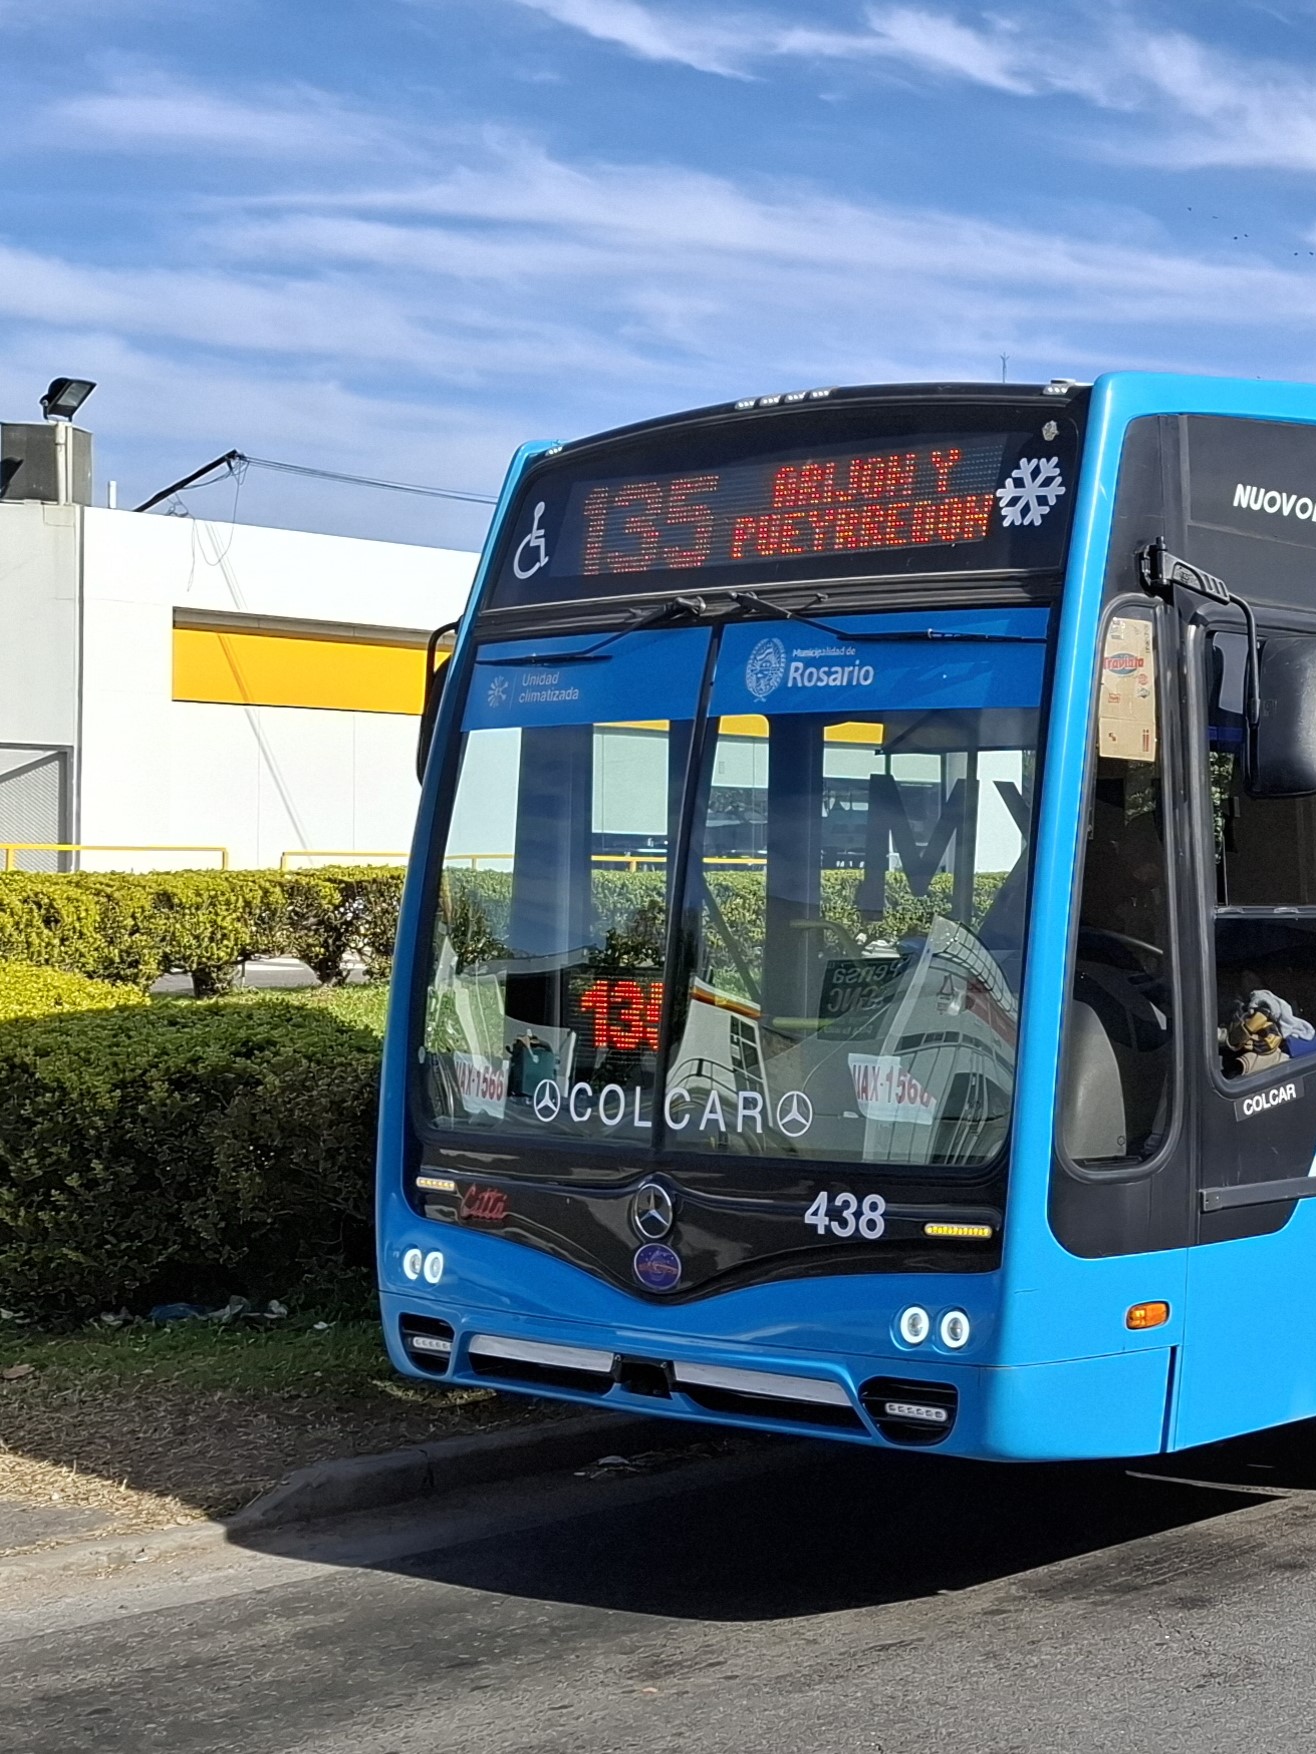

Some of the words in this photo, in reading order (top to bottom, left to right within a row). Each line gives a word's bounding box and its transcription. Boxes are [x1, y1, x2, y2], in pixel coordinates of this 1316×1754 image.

[932, 448, 961, 494] Y
[583, 475, 719, 576] 135
[792, 647, 843, 659] Municipalidad
[845, 647, 856, 657] de
[521, 671, 560, 686] Unidad
[787, 660, 874, 688] Rosario
[518, 686, 580, 704] climatizada
[569, 1081, 764, 1134] COLCAR
[1243, 1083, 1297, 1116] COLCAR
[804, 1190, 887, 1240] 438
